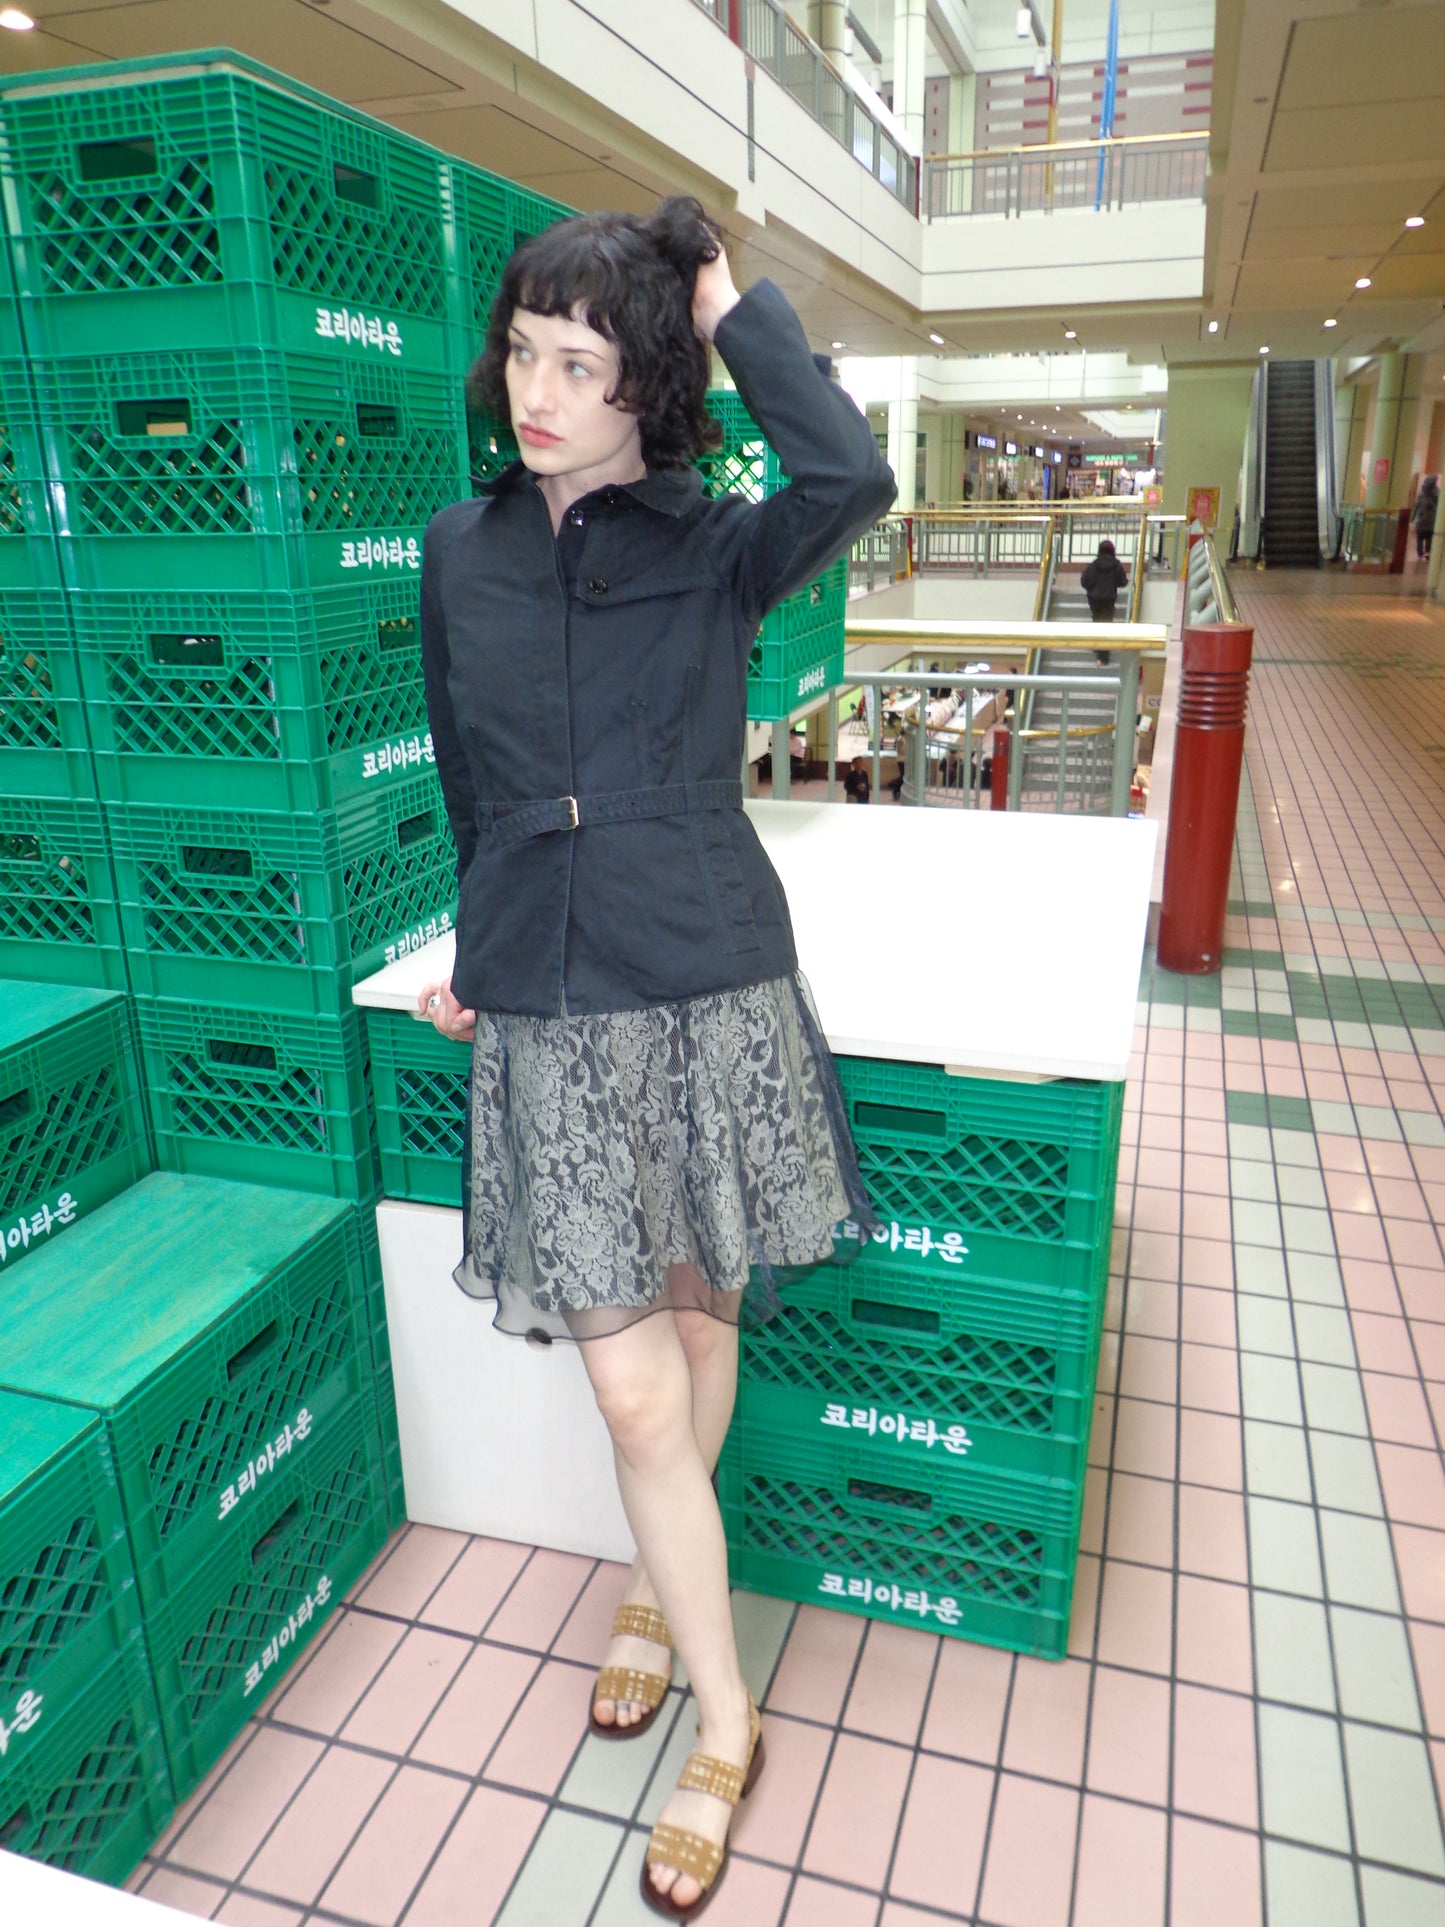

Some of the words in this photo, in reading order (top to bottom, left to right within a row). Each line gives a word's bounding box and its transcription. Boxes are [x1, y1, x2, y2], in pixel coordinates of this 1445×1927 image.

[315, 307, 403, 356] 코리아타운
[339, 536, 421, 570] 코리아타운
[362, 732, 436, 779] 코리아타운
[0, 1192, 78, 1262] 아타운
[820, 1403, 973, 1455] 코리아타운
[218, 1408, 313, 1521] 코리아타운
[818, 1573, 964, 1625] 코리아타운
[243, 1575, 333, 1698] 코리아타운
